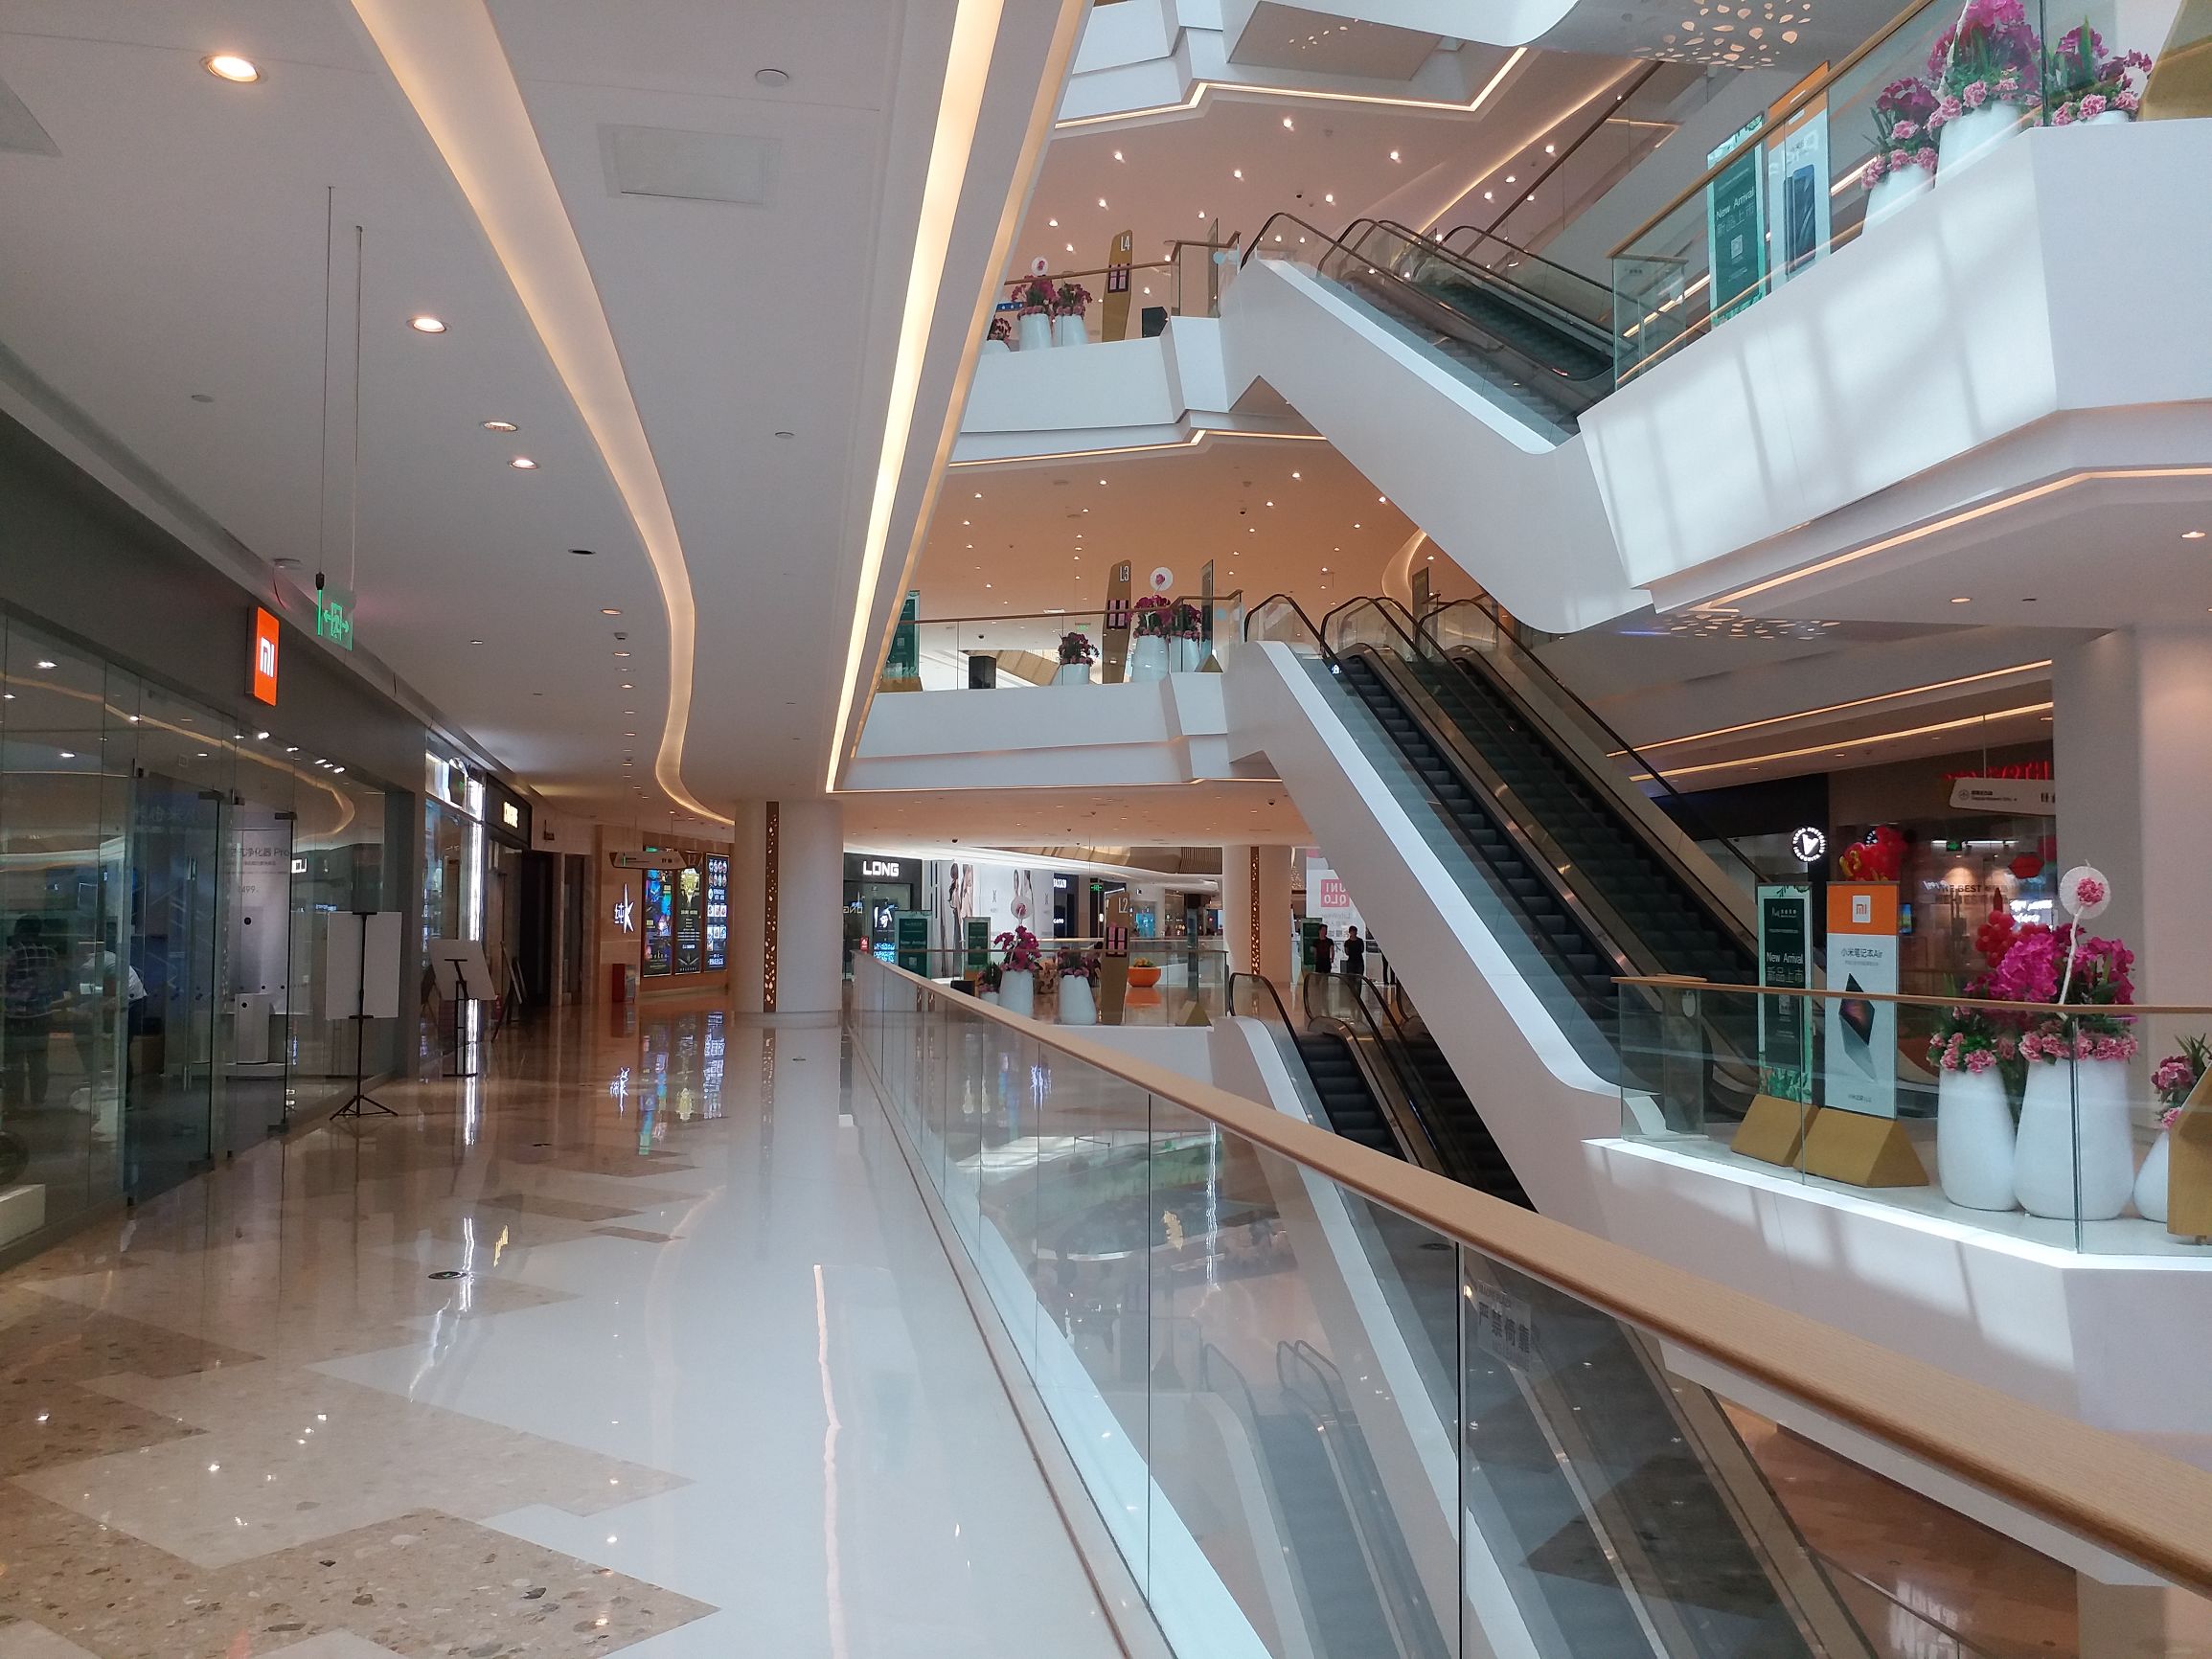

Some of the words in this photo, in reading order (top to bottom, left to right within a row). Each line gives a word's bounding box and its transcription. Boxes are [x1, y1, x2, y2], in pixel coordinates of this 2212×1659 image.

[1716, 205, 1731, 221] New
[1733, 186, 1755, 210] Arrival
[1120, 236, 1130, 251] L4
[1119, 565, 1129, 581] L3
[863, 861, 900, 877] LONG
[1957, 884, 1982, 893] BEST
[1118, 897, 1129, 914] L2
[1767, 951, 1781, 963] New
[1783, 952, 1804, 965] Arrival
[1767, 966, 1804, 984] 新品上市
